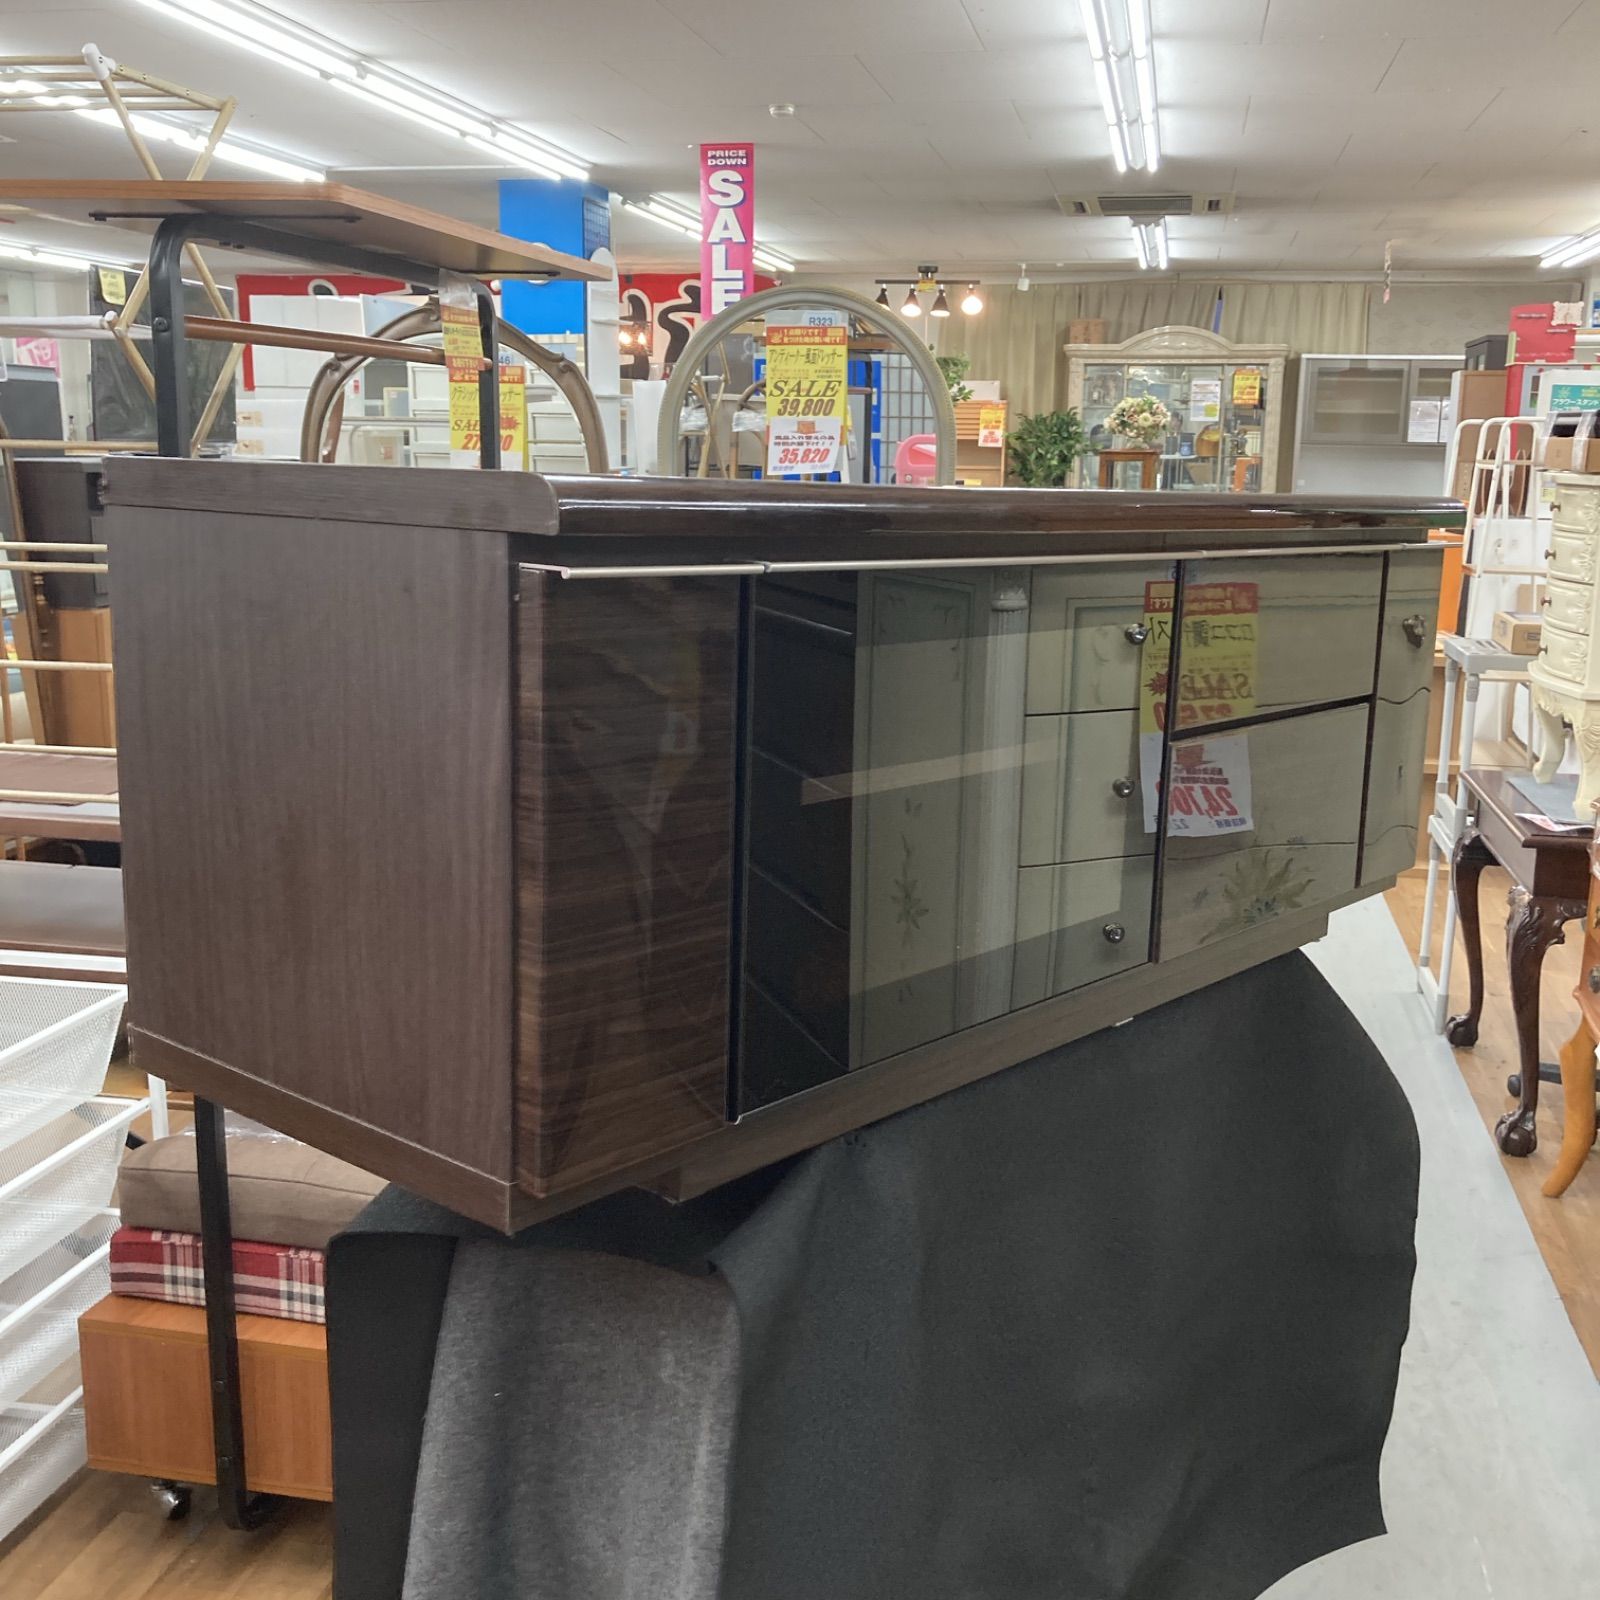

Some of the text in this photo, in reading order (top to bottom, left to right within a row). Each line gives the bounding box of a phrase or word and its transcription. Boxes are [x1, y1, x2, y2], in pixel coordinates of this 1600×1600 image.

[707, 149, 746, 158] PRICE
[707, 157, 747, 166] DOWN
[707, 169, 746, 315] SALE
[808, 316, 833, 326] R323
[768, 380, 842, 397] SALE
[777, 398, 835, 417] 39,800
[452, 419, 480, 431] SAL
[778, 447, 831, 465] 35,820
